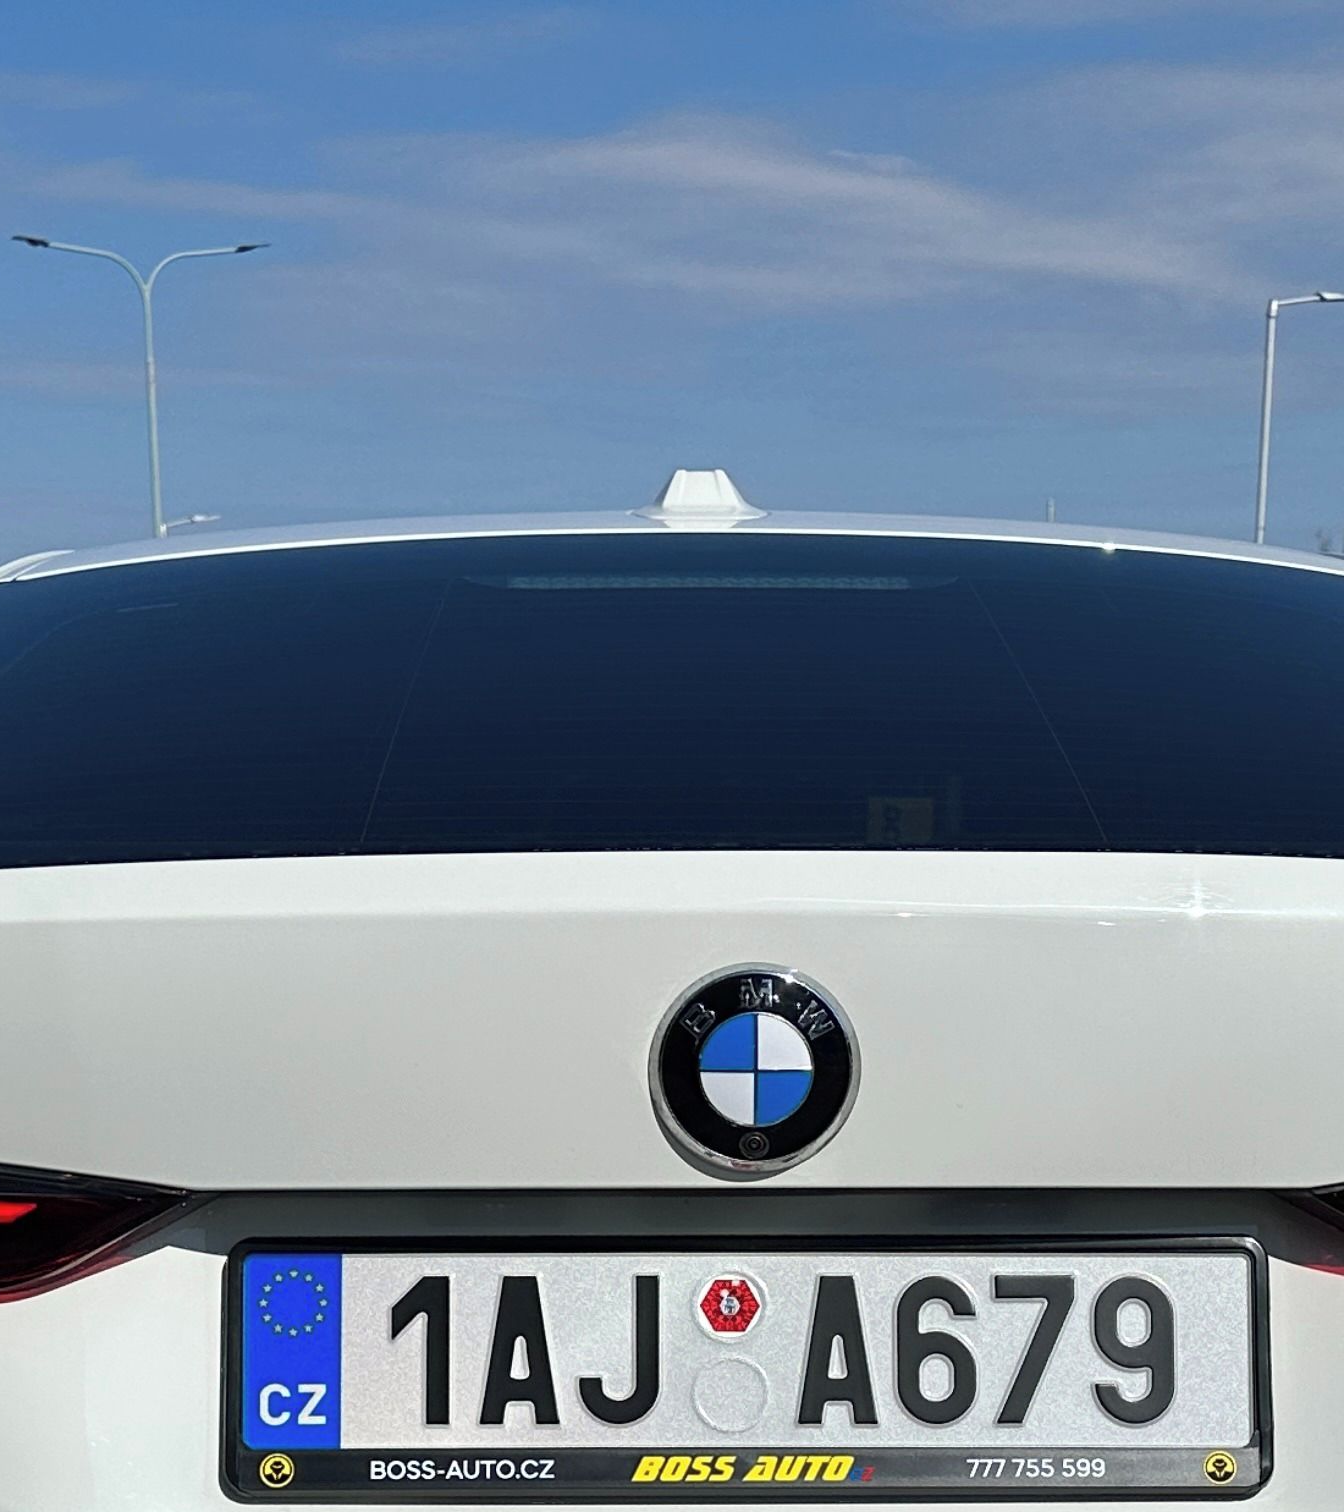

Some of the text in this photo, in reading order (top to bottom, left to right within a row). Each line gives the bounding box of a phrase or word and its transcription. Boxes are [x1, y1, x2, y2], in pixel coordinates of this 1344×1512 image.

[679, 978, 836, 1041] BMW
[390, 1275, 1176, 1426] 1AJ A679
[258, 1384, 327, 1425] CZ
[369, 1459, 555, 1480] BOSS-AUTO.CZ
[631, 1456, 737, 1482] BOSS
[742, 1456, 855, 1482] AUTO
[966, 1458, 1106, 1478] 777 755 599
